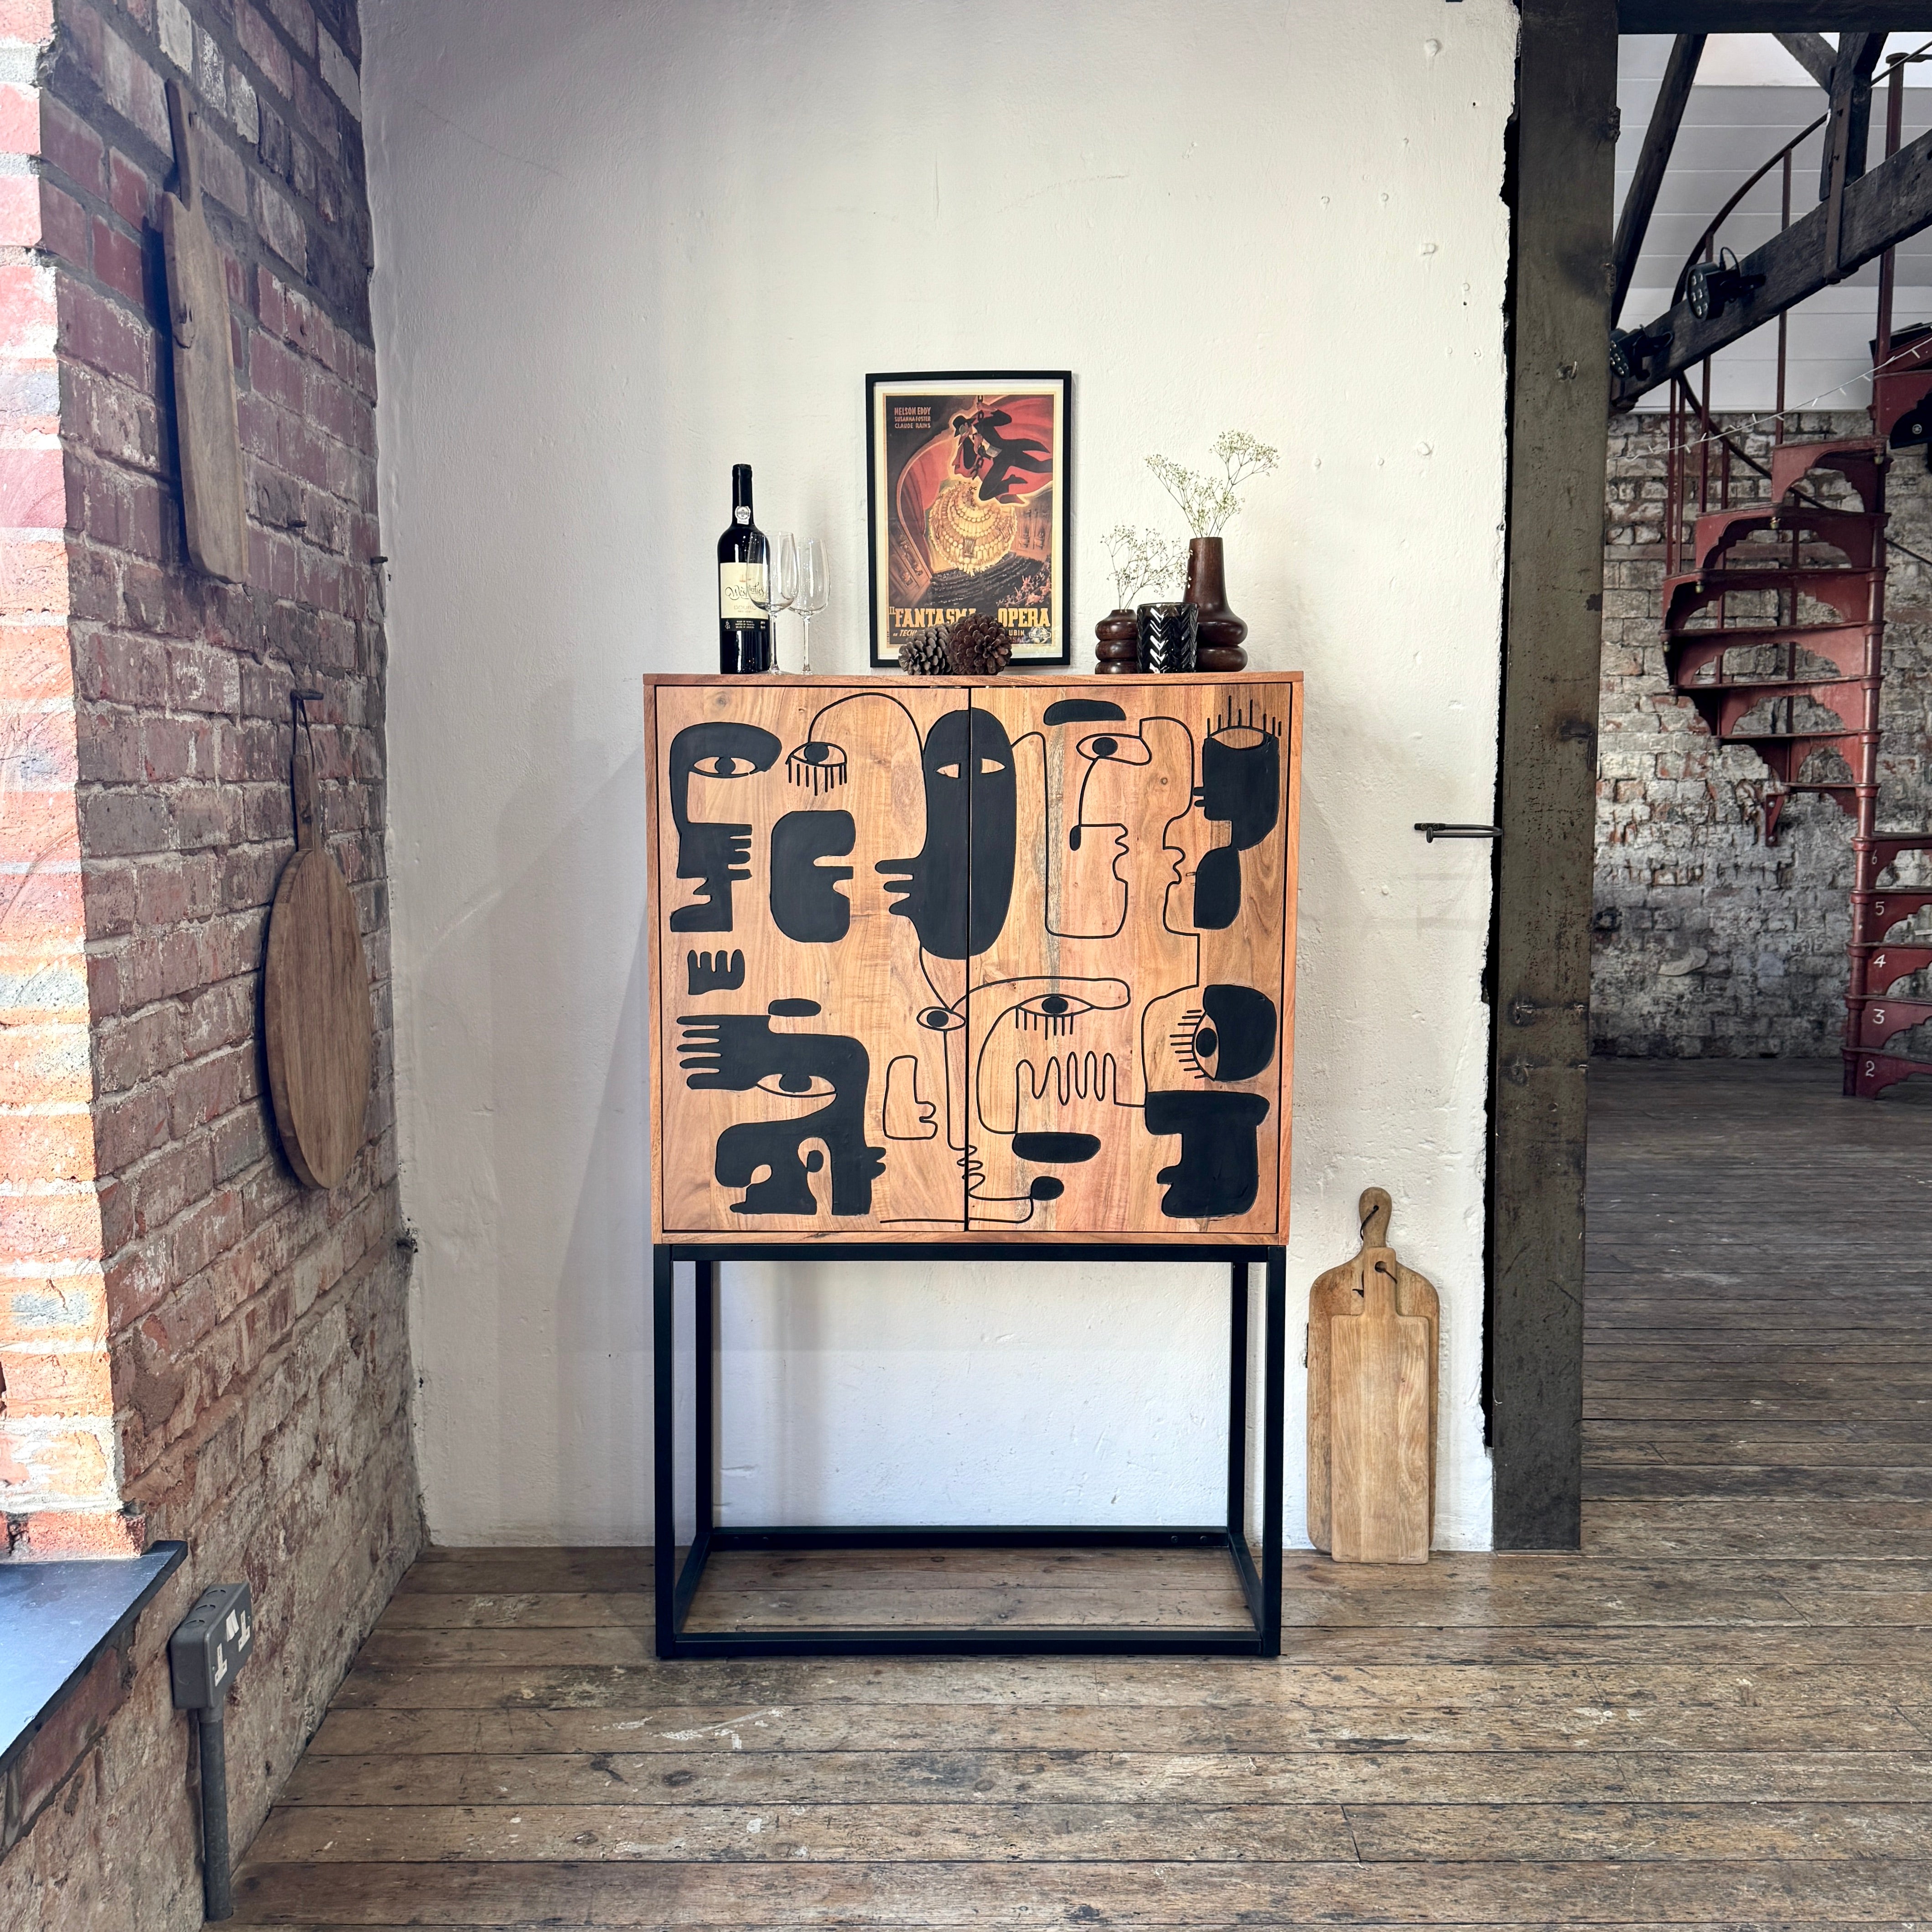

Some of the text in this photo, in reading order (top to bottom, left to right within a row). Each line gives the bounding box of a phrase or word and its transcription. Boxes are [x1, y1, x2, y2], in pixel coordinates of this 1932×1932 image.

[894, 407, 931, 415] NELSON EDDY
[998, 608, 1051, 627] OPERA
[1871, 849, 1877, 865] 6
[1875, 901, 1885, 916] 5
[1873, 954, 1886, 968] 4
[1873, 1009, 1885, 1024] 3
[1865, 1061, 1875, 1077] 2
